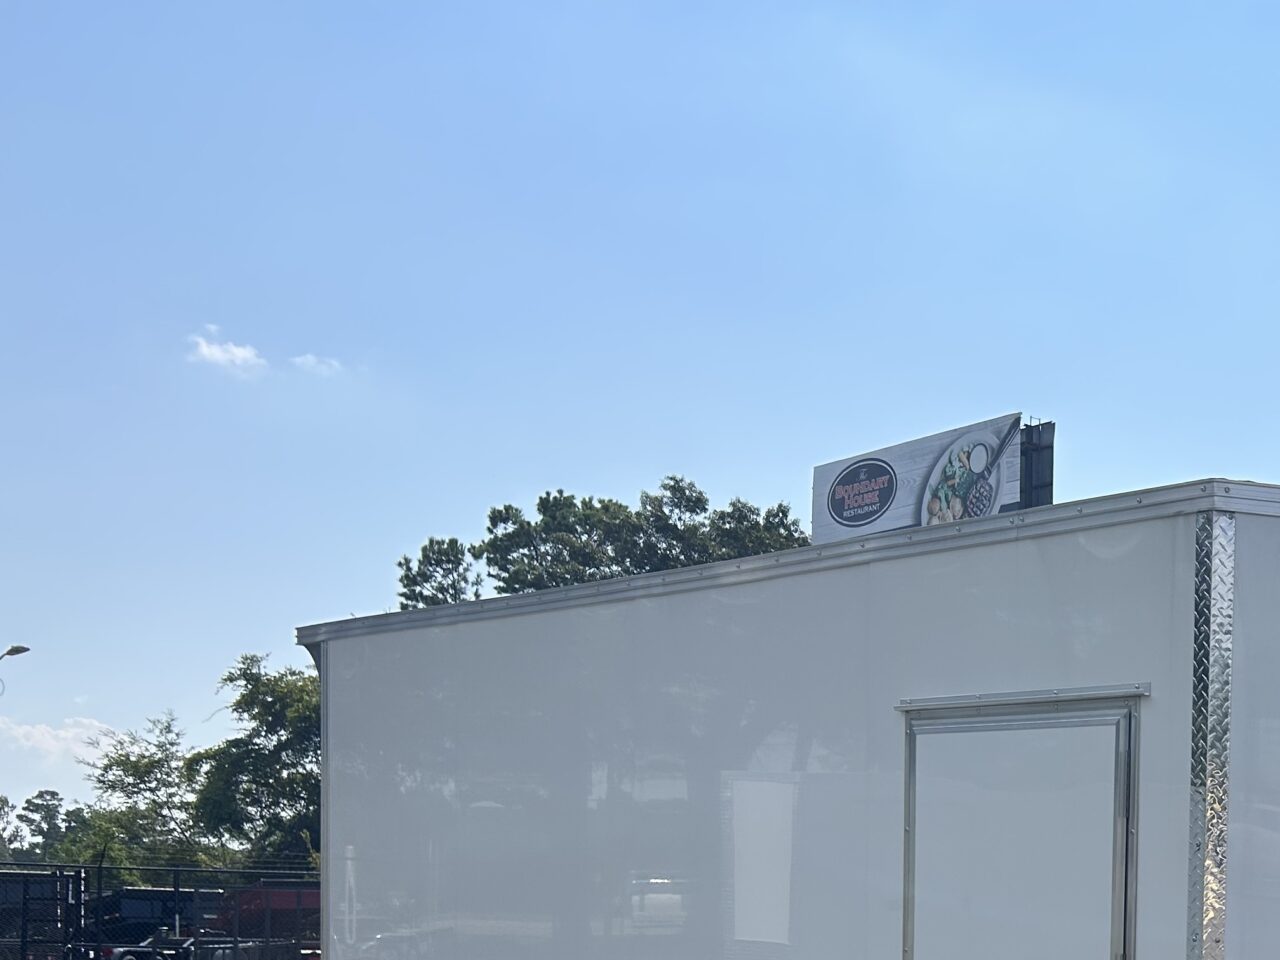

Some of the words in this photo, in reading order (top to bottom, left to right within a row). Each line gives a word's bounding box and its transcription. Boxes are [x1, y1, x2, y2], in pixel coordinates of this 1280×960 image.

[835, 475, 890, 499] BOUNDARY
[844, 491, 880, 509] HOUSE
[843, 503, 880, 518] RESTAURANT
